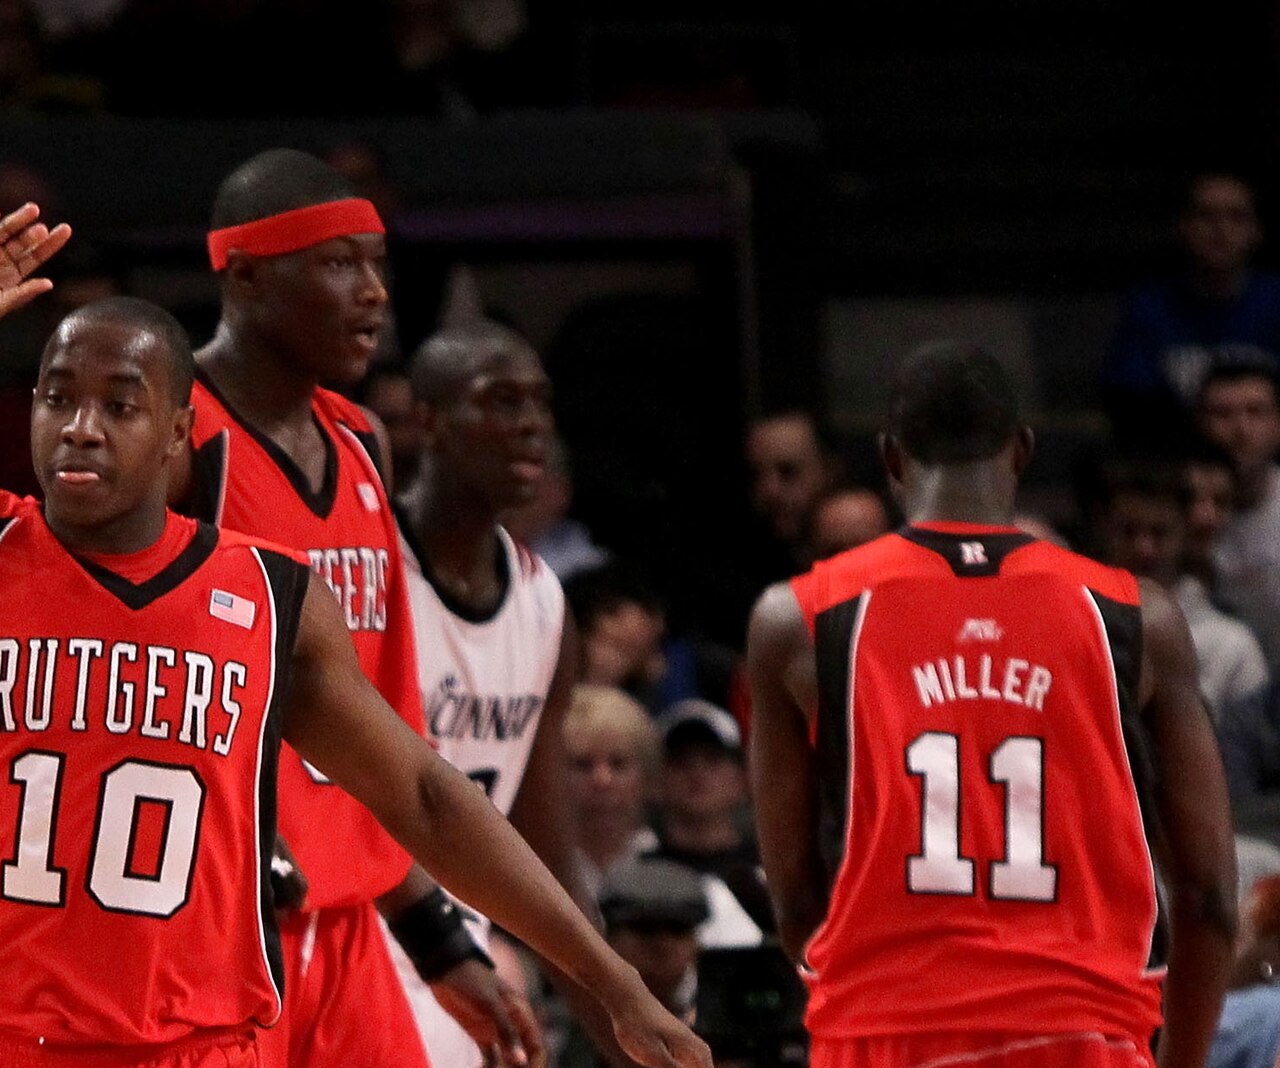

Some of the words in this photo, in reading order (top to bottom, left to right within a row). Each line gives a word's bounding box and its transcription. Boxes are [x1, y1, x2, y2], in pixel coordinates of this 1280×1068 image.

[913, 654, 1052, 712] MILLER
[0, 750, 206, 918] 10
[904, 730, 1058, 902] 11
